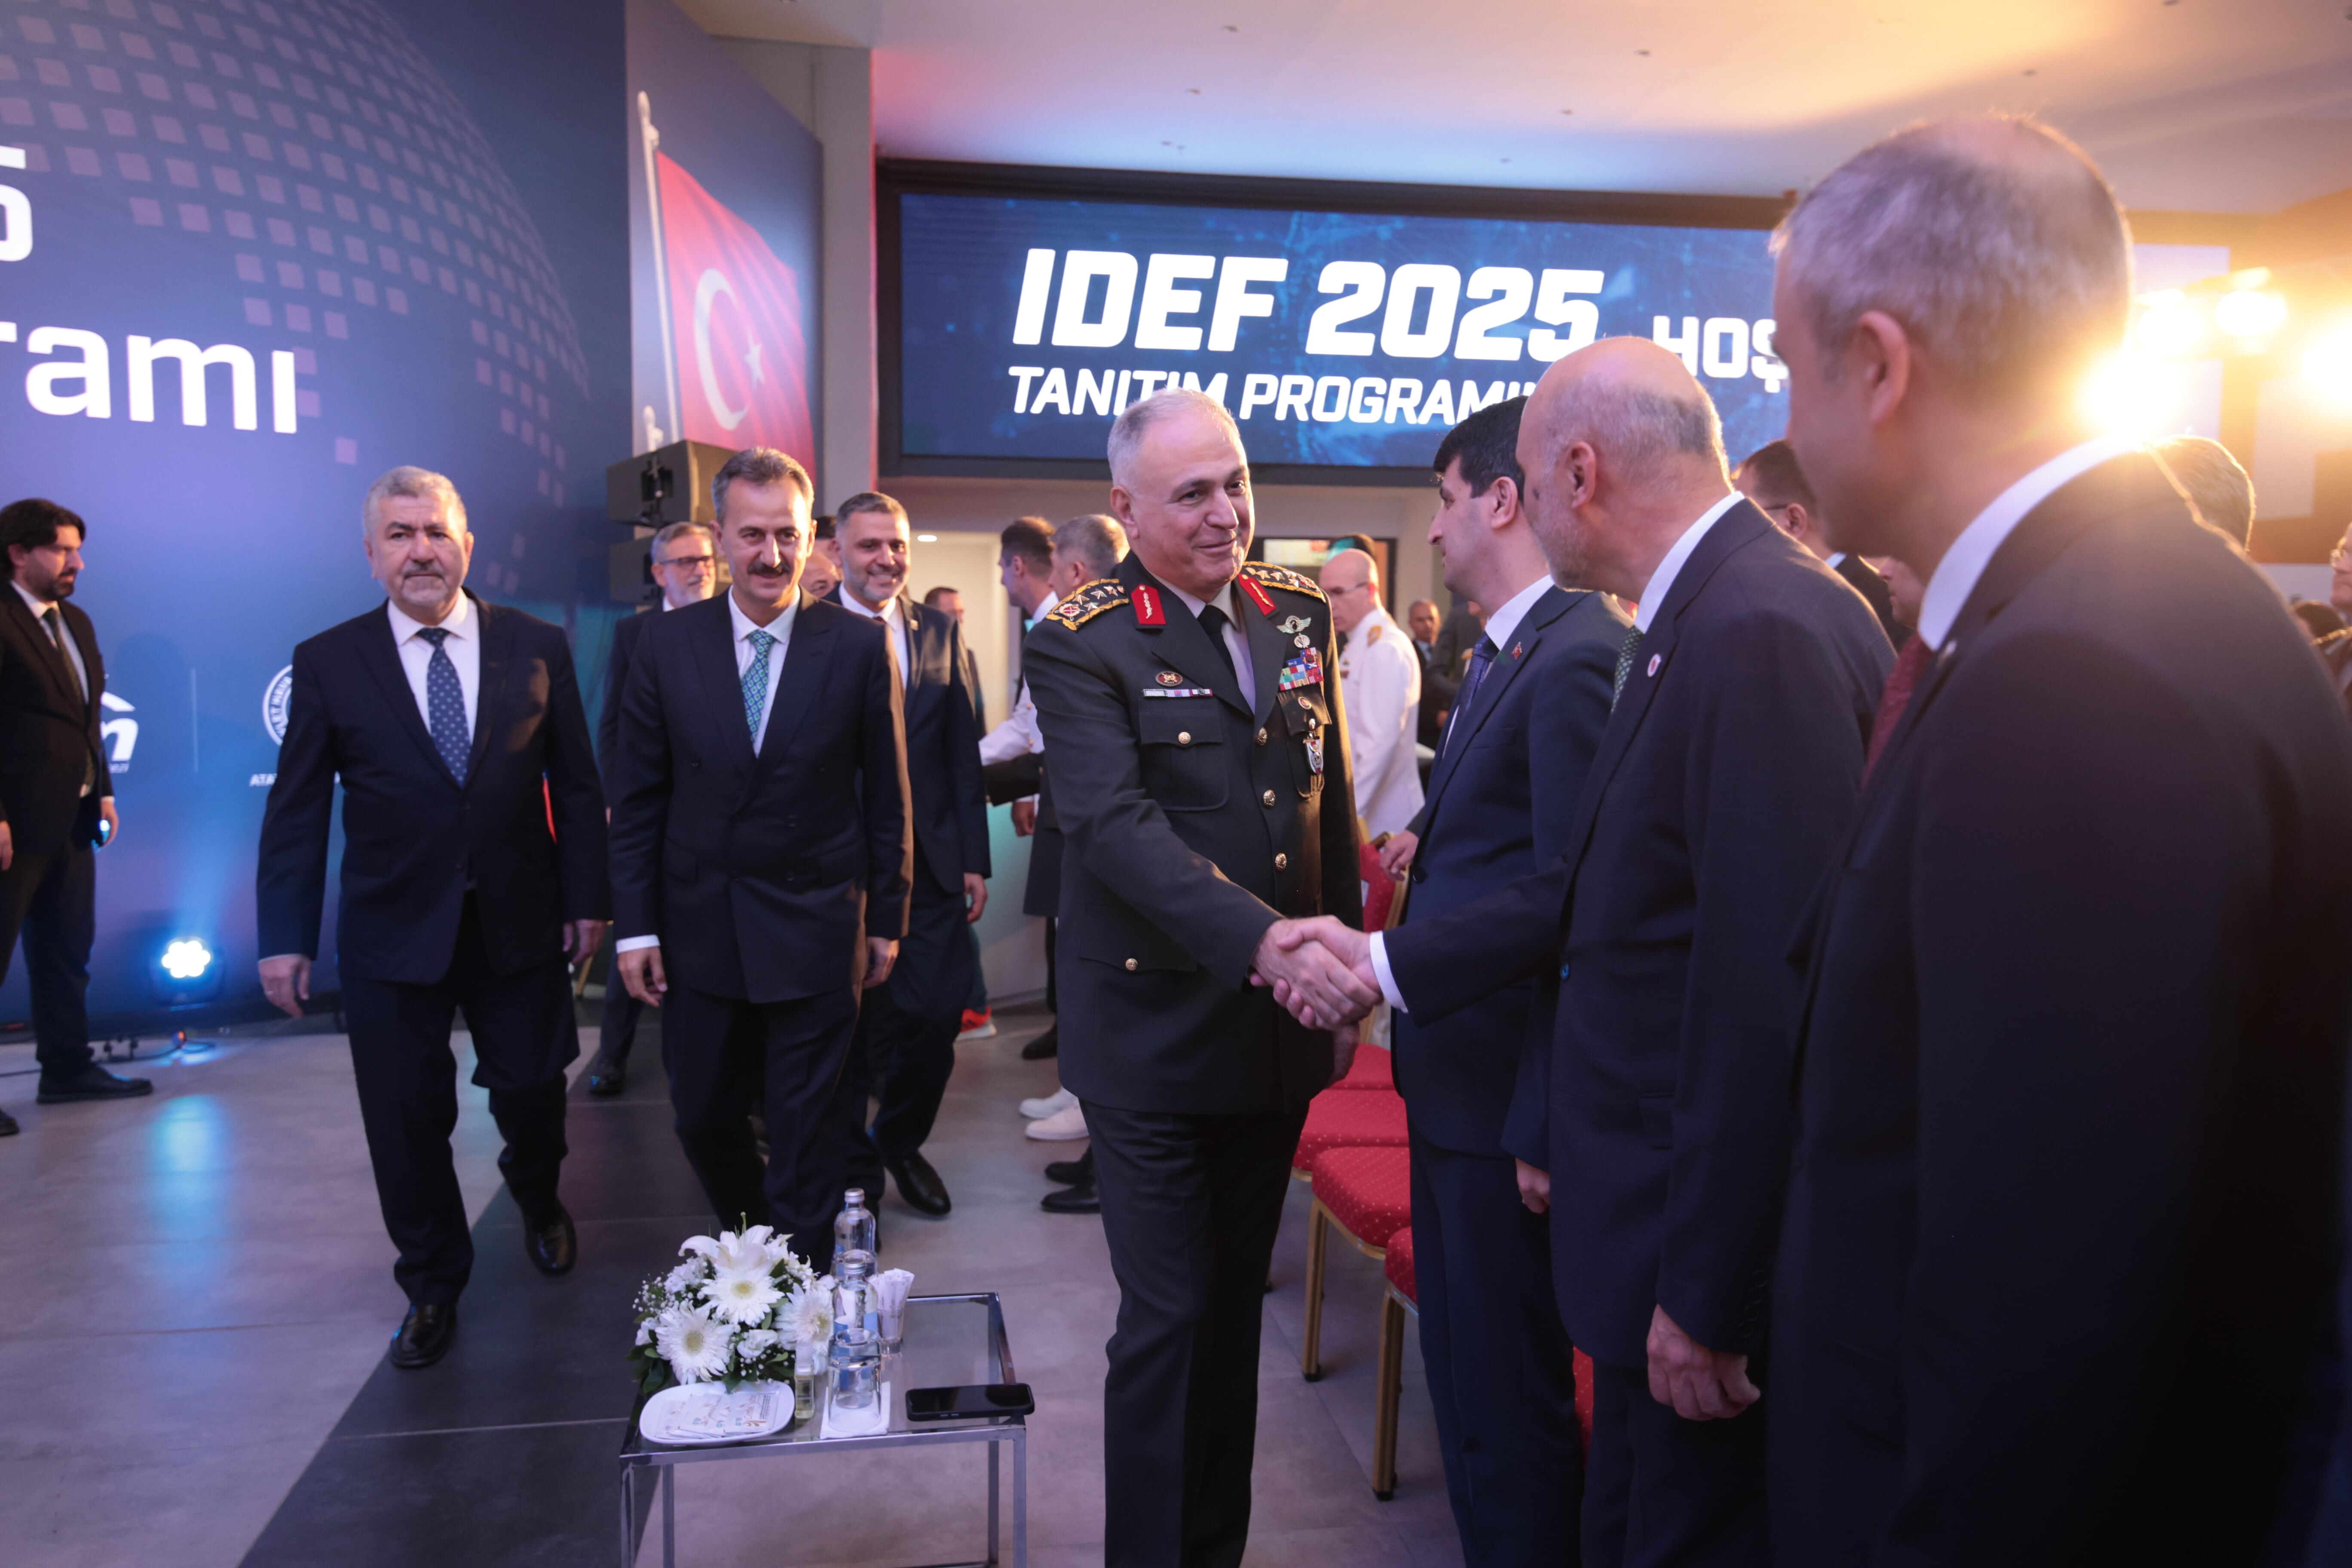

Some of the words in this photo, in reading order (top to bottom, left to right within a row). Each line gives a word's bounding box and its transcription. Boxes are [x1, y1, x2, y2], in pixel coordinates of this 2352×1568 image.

[1012, 248, 1289, 352] IDEF
[1305, 260, 1605, 362] 2025
[0, 322, 297, 434] amı
